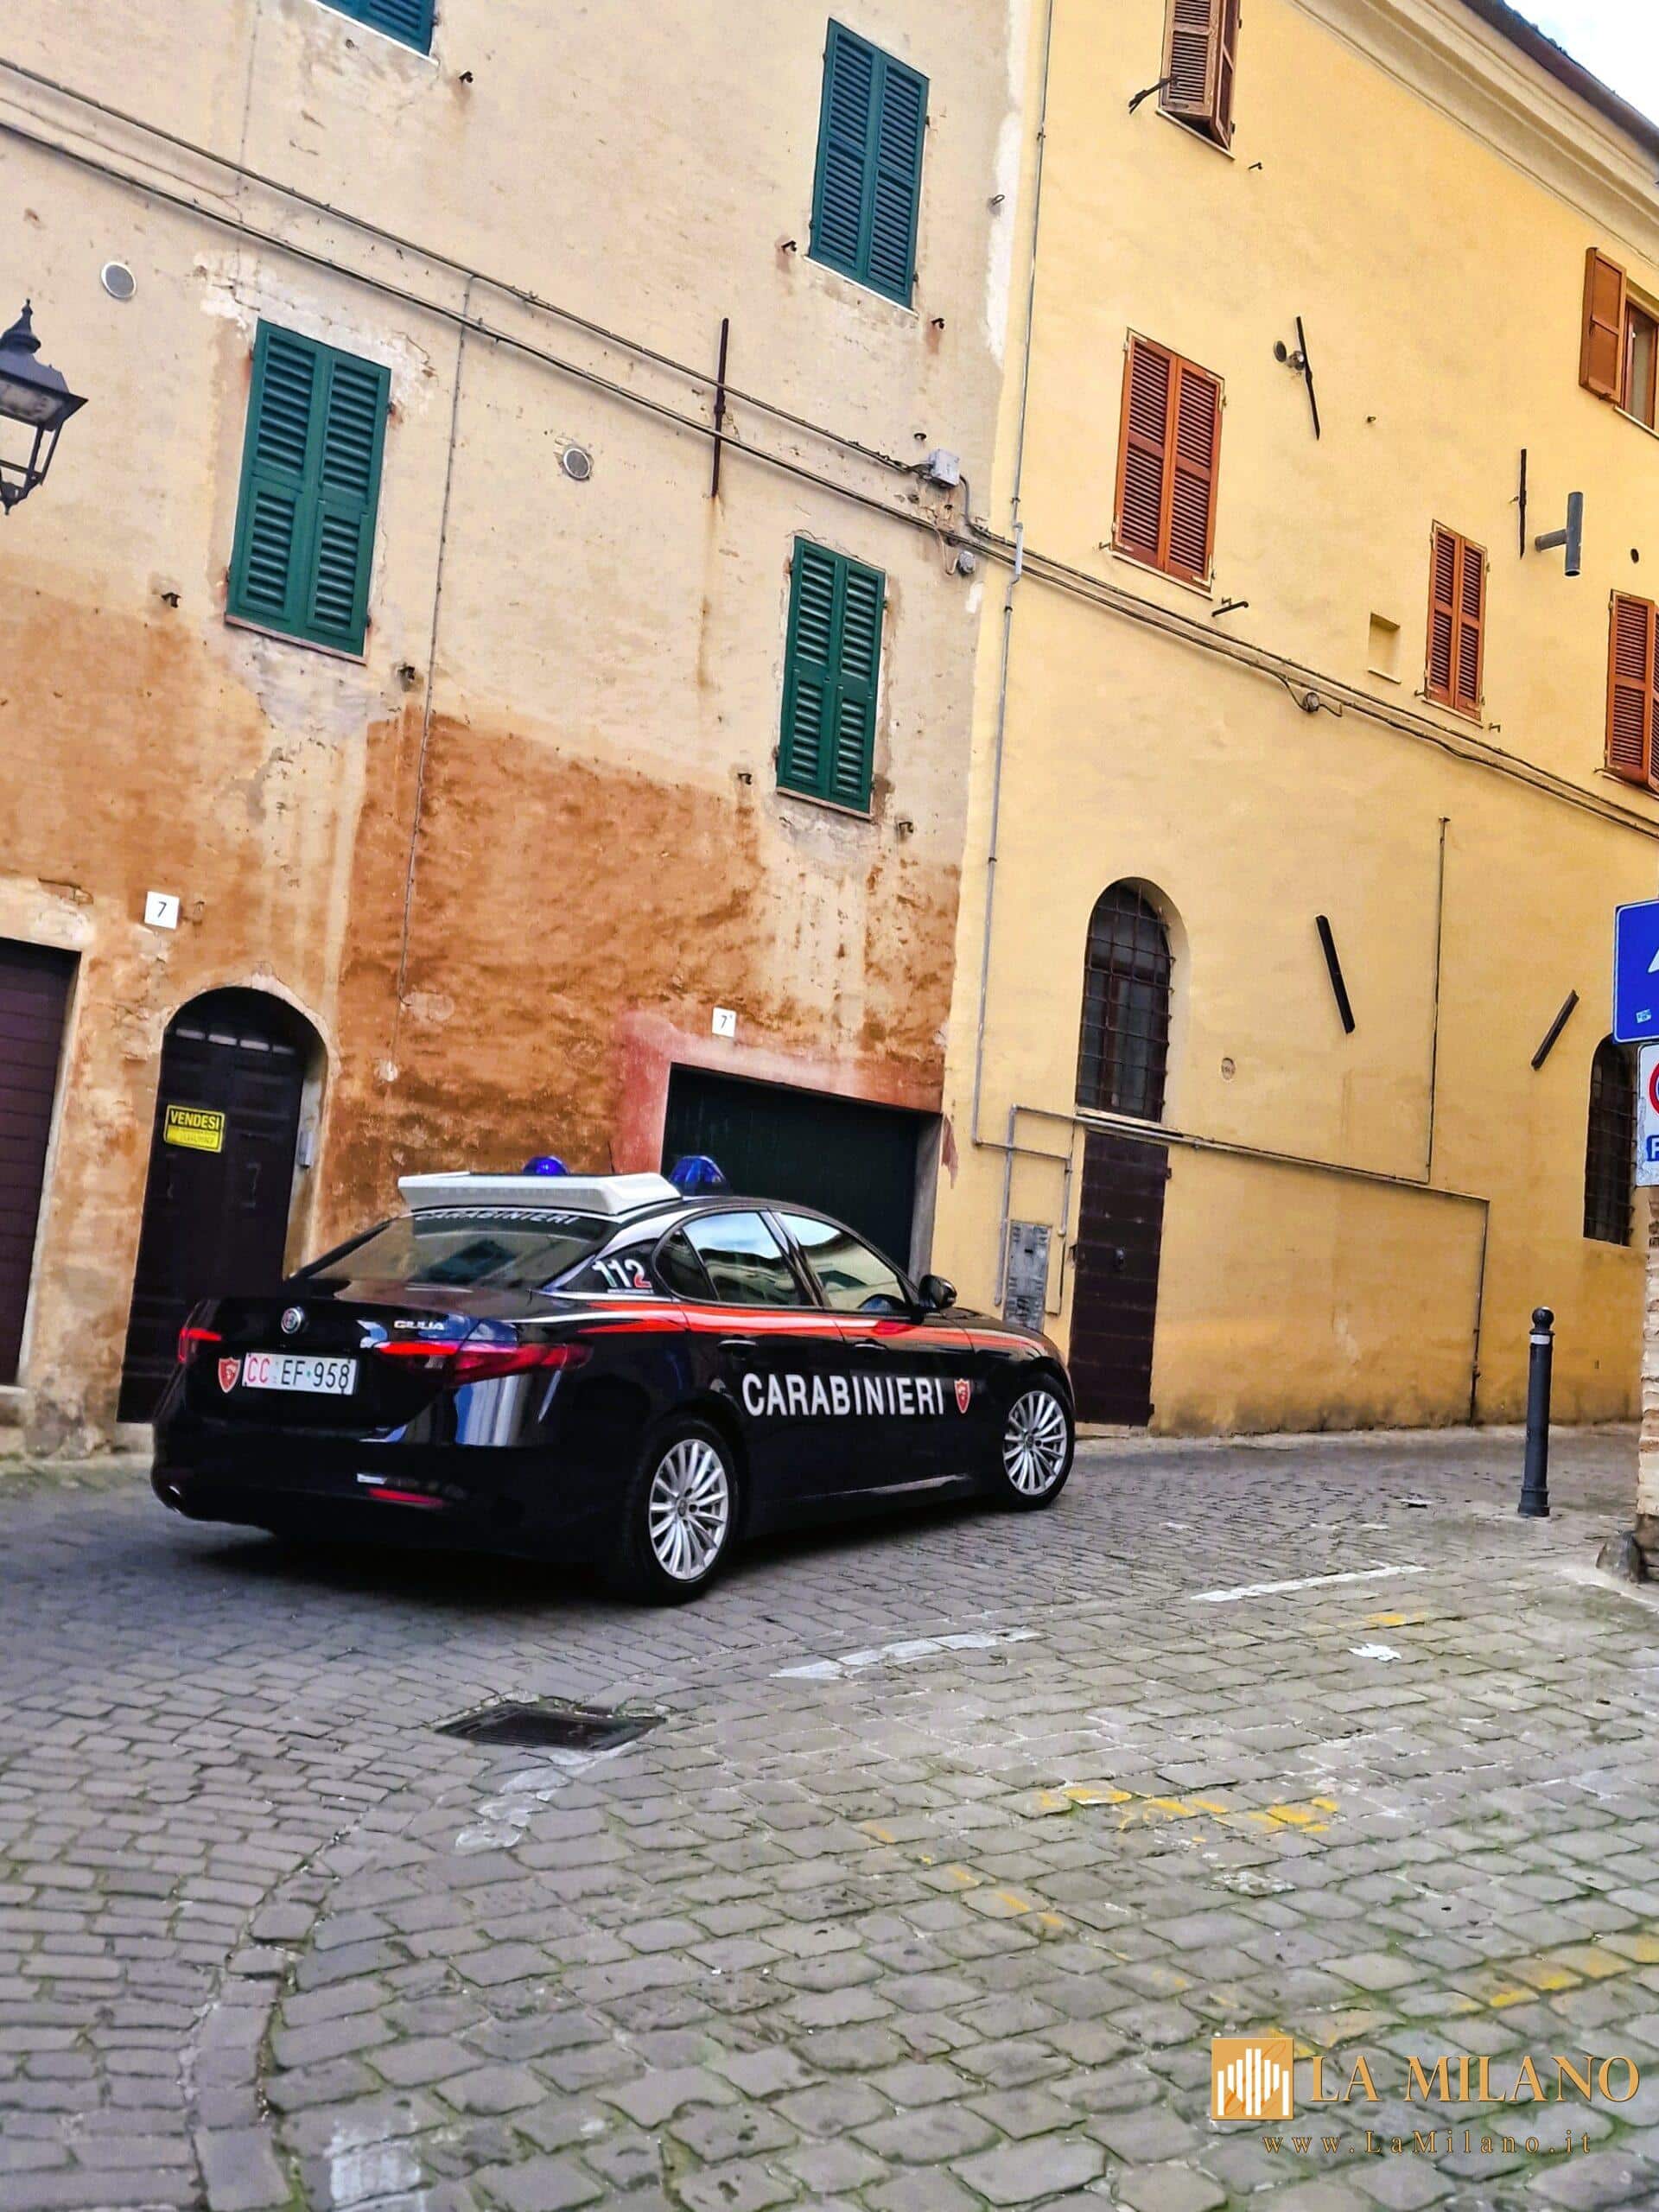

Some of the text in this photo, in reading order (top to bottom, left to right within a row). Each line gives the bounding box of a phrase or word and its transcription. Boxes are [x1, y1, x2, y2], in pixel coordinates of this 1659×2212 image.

[157, 900, 168, 918] 7
[721, 1014, 728, 1030] 7
[170, 1109, 220, 1131] VENDESI
[592, 1258, 652, 1288] 112
[247, 1357, 350, 1389] CC EF 958
[742, 1372, 944, 1416] CARABINIERI
